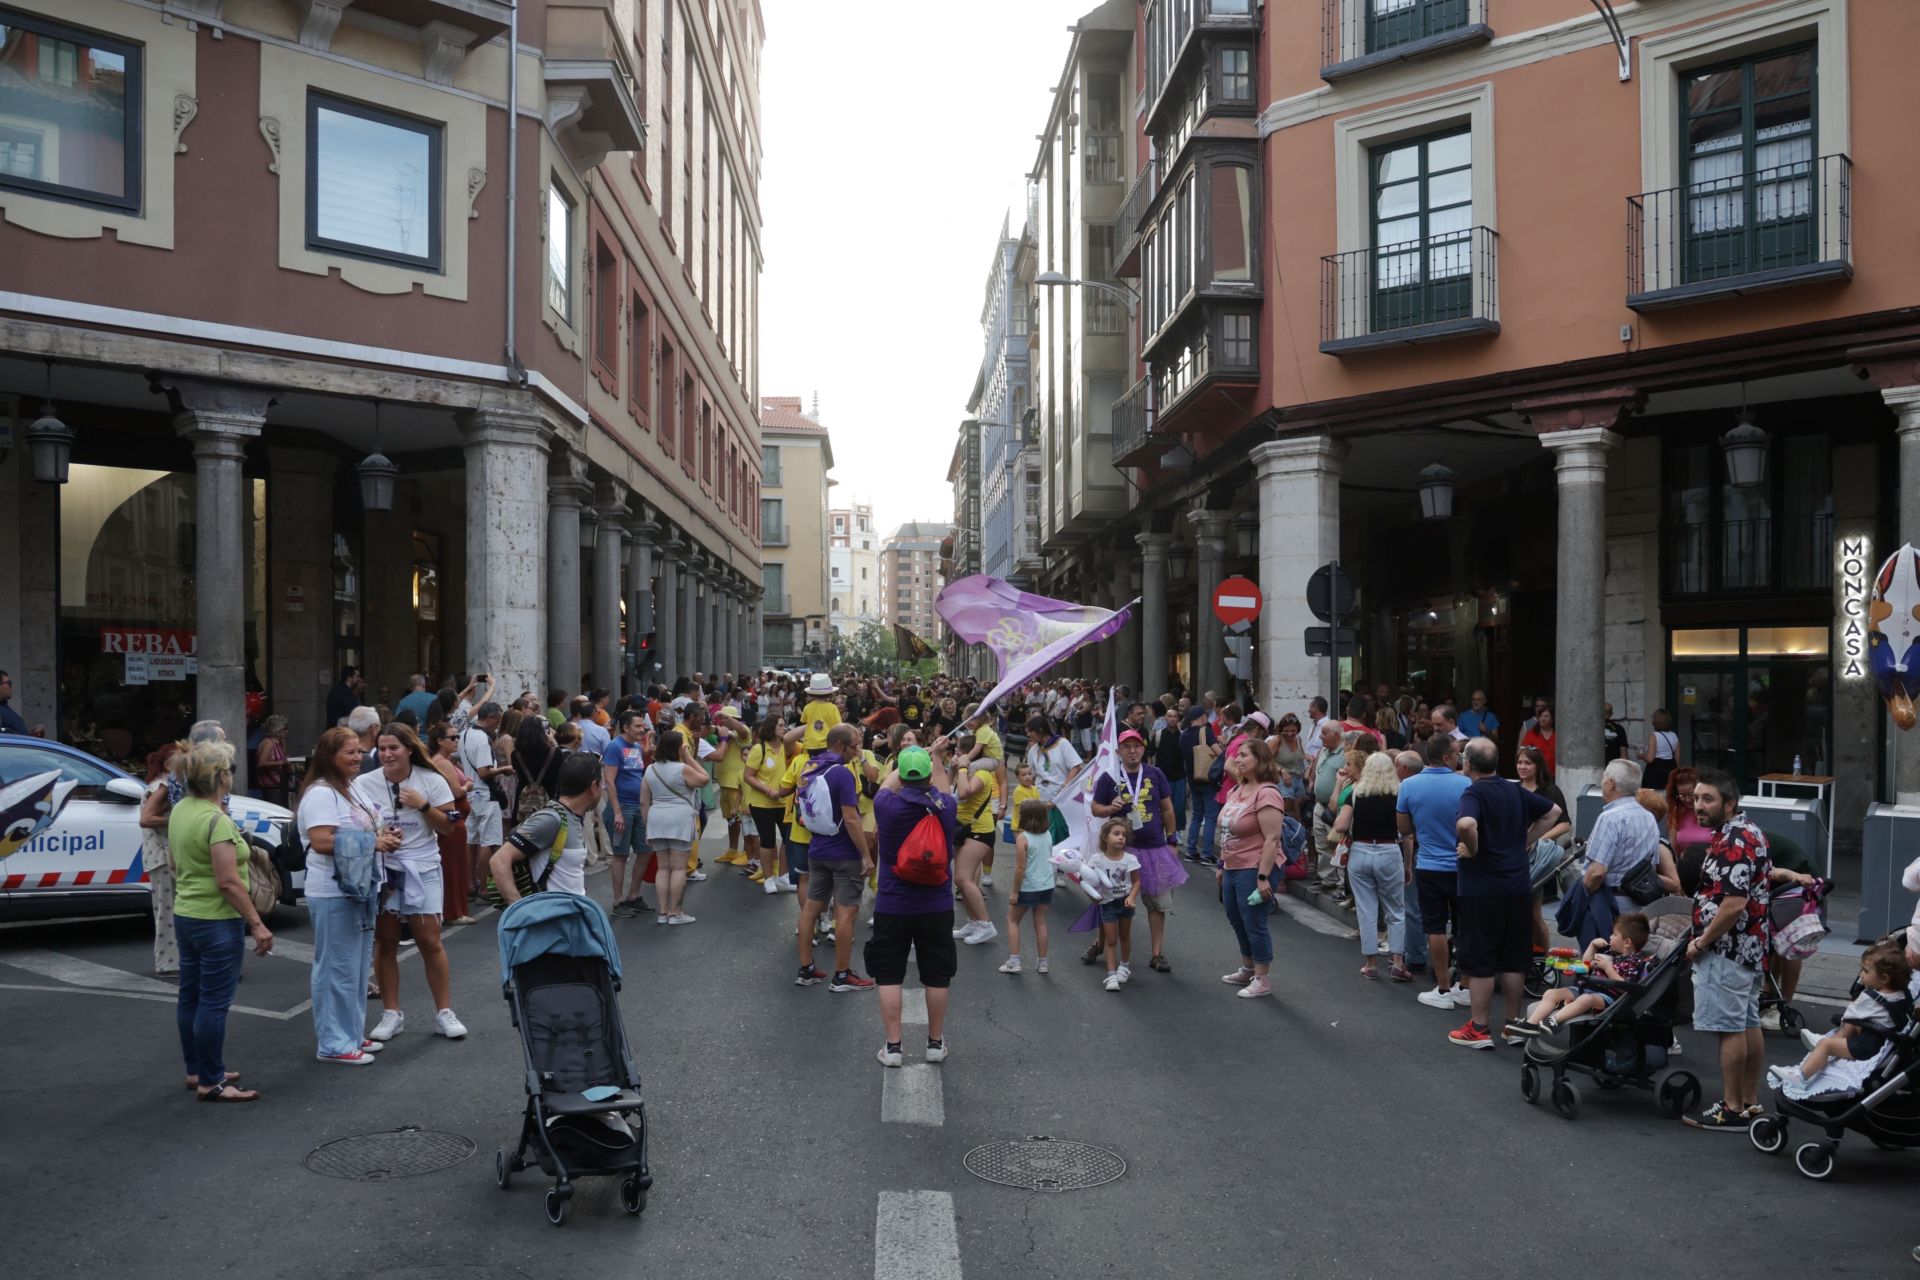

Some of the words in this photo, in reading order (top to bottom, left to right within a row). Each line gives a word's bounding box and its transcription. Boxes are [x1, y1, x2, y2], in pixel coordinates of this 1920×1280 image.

[1843, 539, 1863, 676] MONCASA
[103, 632, 197, 655] REBAJ
[17, 829, 105, 856] nicipal
